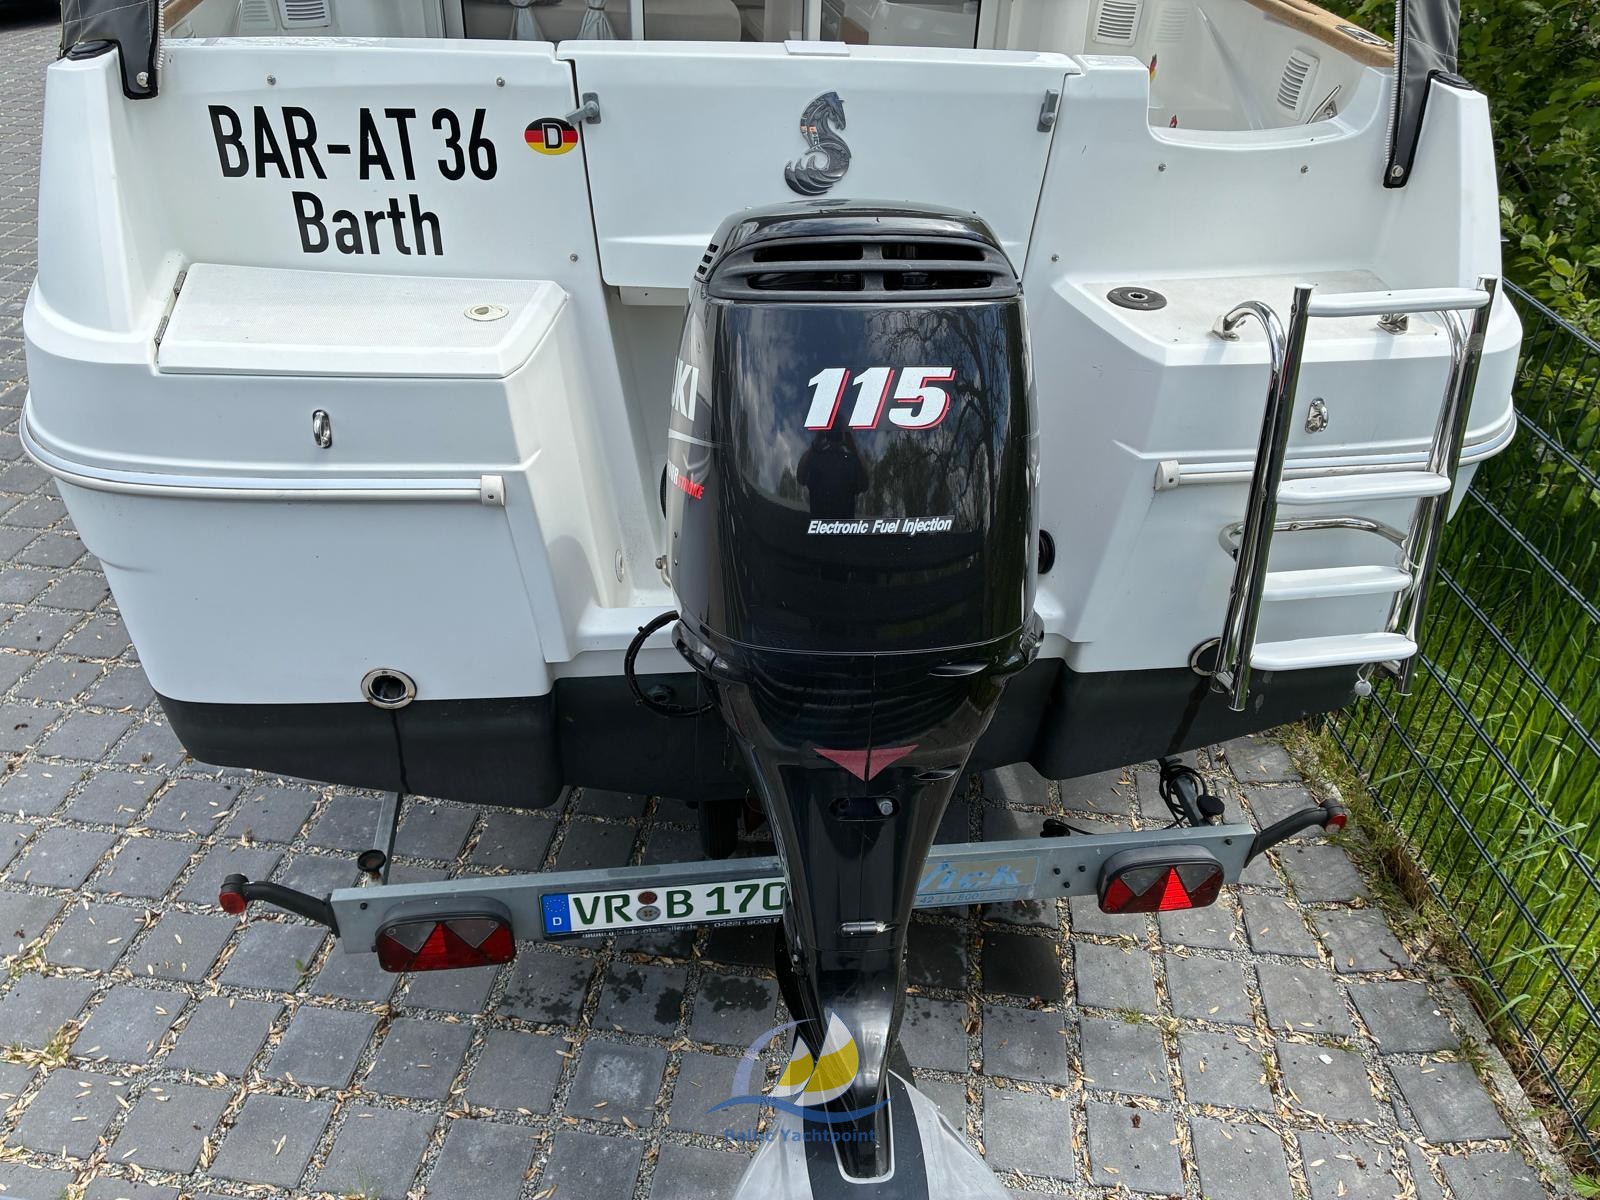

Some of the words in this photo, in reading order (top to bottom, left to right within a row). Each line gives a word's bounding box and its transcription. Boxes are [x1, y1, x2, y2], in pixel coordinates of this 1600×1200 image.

[208, 104, 416, 180] BAR-AT
[432, 108, 497, 181] 36
[542, 123, 563, 149] D
[292, 191, 443, 255] Barth
[804, 367, 957, 430] 115
[808, 520, 869, 534] Electronic
[872, 519, 900, 534] Fuel
[902, 517, 953, 536] Injection
[552, 917, 562, 926] D
[573, 893, 633, 925] VR
[666, 889, 694, 919] B
